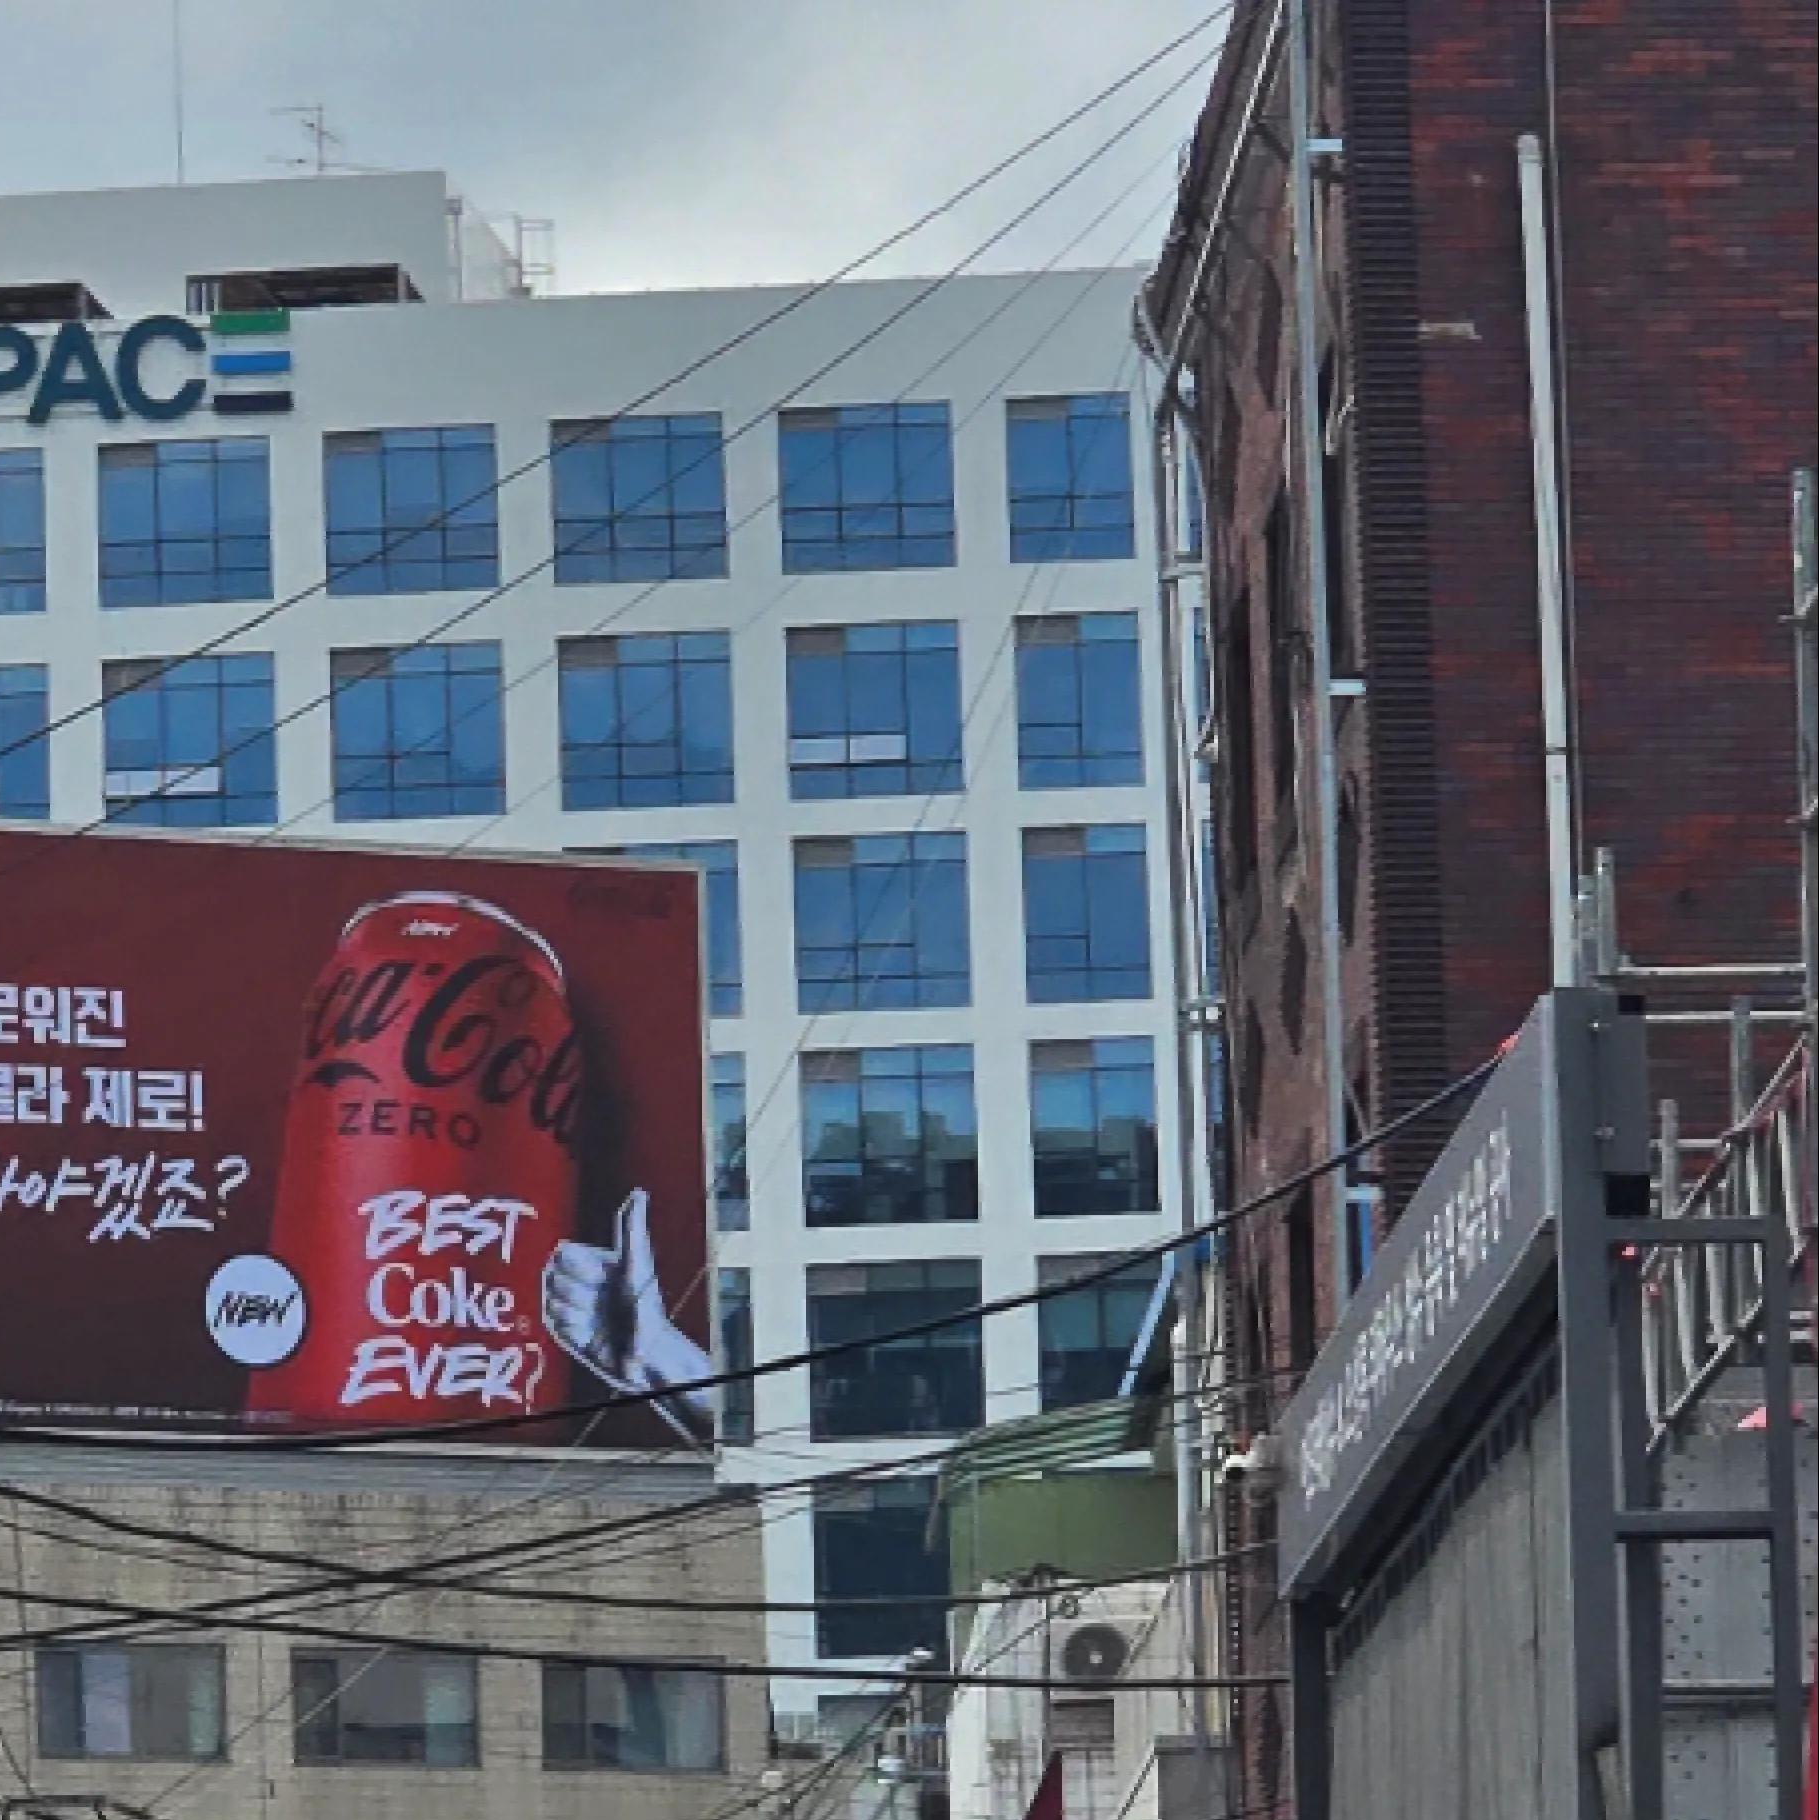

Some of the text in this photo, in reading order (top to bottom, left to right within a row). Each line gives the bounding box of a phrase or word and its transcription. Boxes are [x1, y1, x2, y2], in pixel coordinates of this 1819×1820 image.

[82, 1065, 206, 1132] 제로!
[337, 1099, 481, 1151] ZERO
[356, 1189, 539, 1264] BEST
[213, 1289, 302, 1328] NEW
[367, 1261, 516, 1332] Coke
